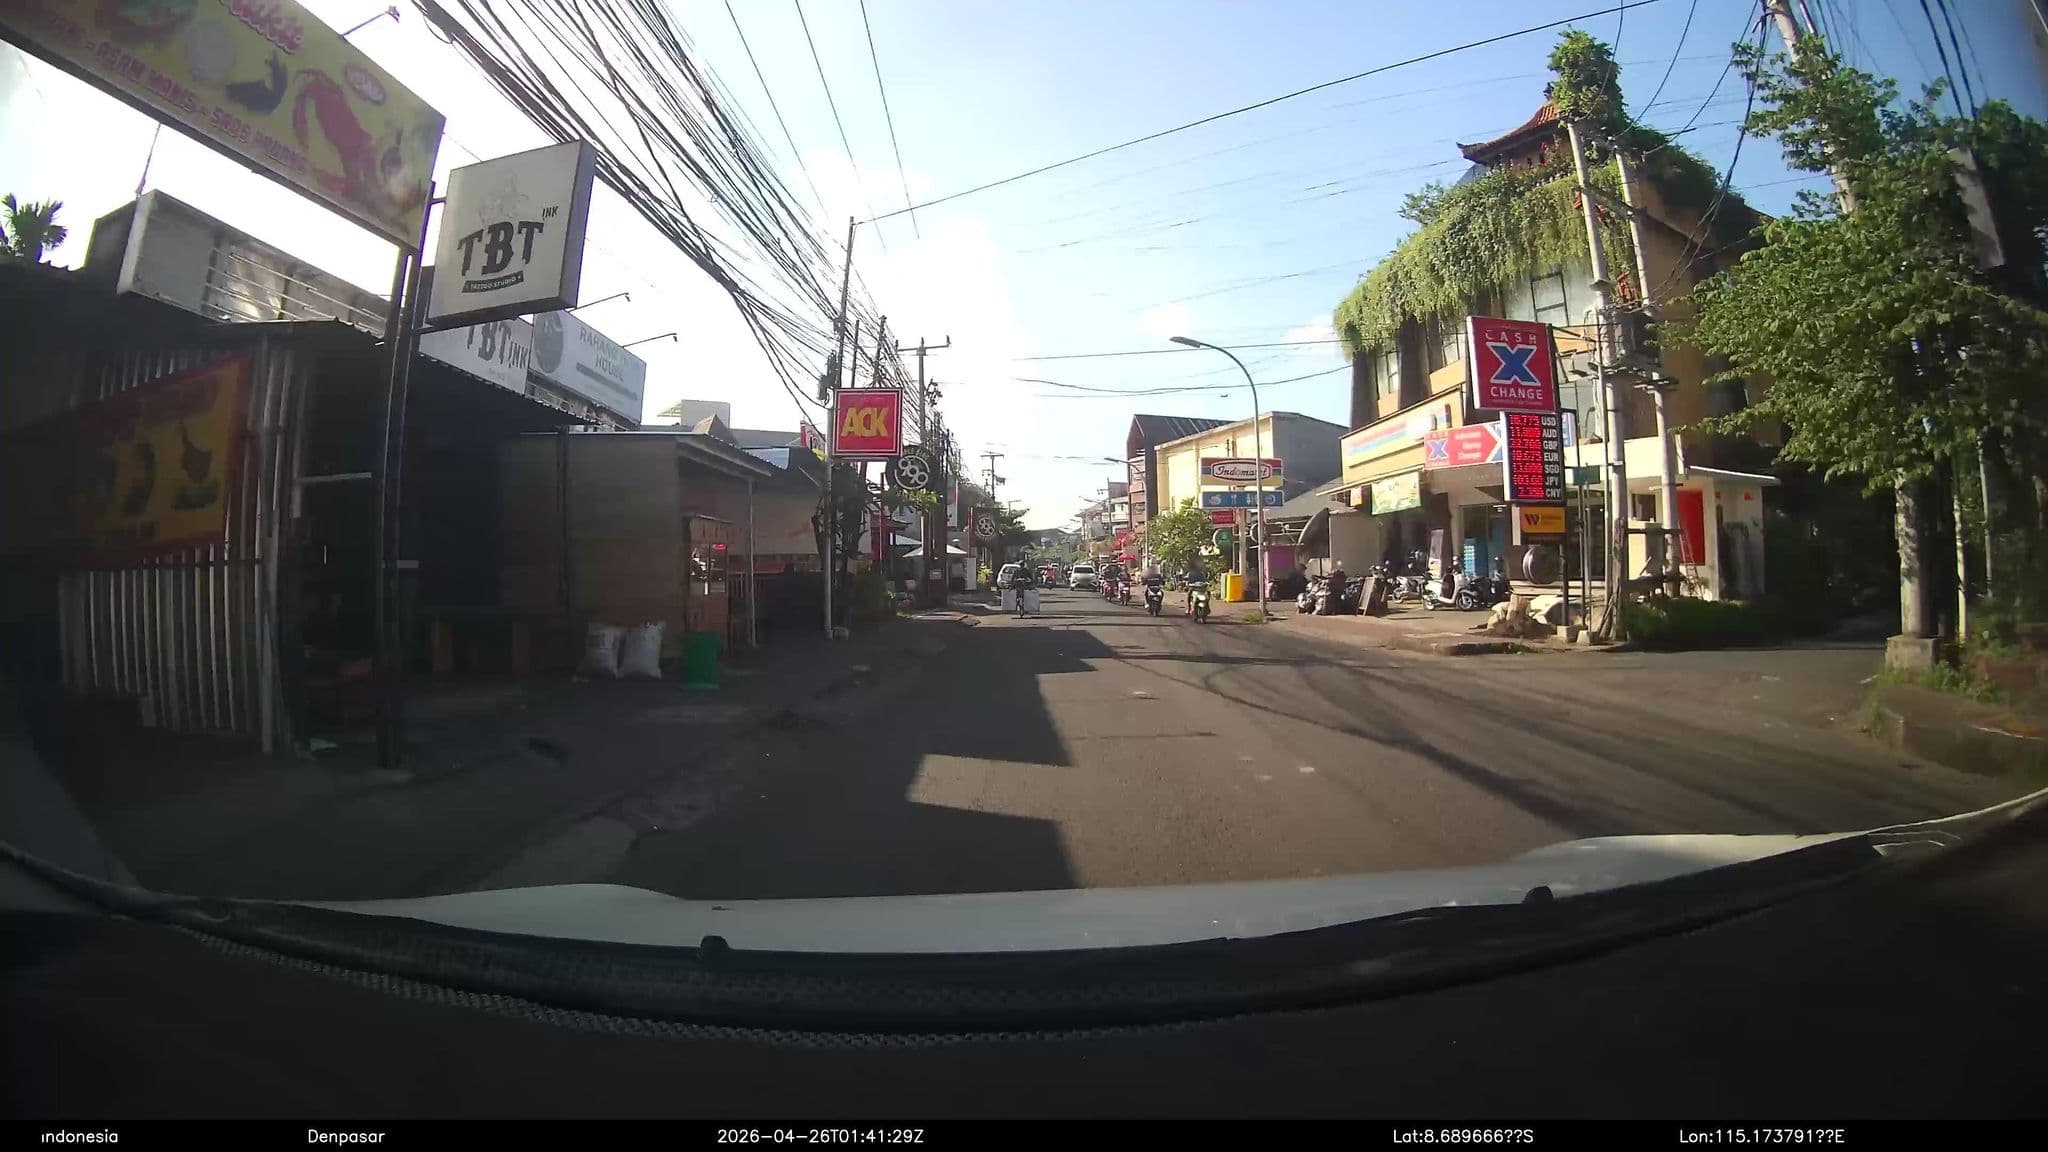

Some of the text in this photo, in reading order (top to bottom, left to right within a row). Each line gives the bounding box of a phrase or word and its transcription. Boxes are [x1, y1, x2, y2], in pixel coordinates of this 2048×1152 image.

[457, 206, 559, 277] TBT INK
[1485, 329, 1538, 344] CASH
[508, 341, 529, 369] INK
[1485, 341, 1542, 387] X
[1490, 386, 1544, 400] CHANGE
[1541, 416, 1557, 426] USD
[1542, 428, 1557, 438] AUD
[1543, 440, 1558, 450] GBP
[1544, 452, 1559, 462] EUR
[1544, 464, 1560, 474] SGD
[1545, 476, 1559, 486] JPY
[1545, 488, 1561, 498] CNY
